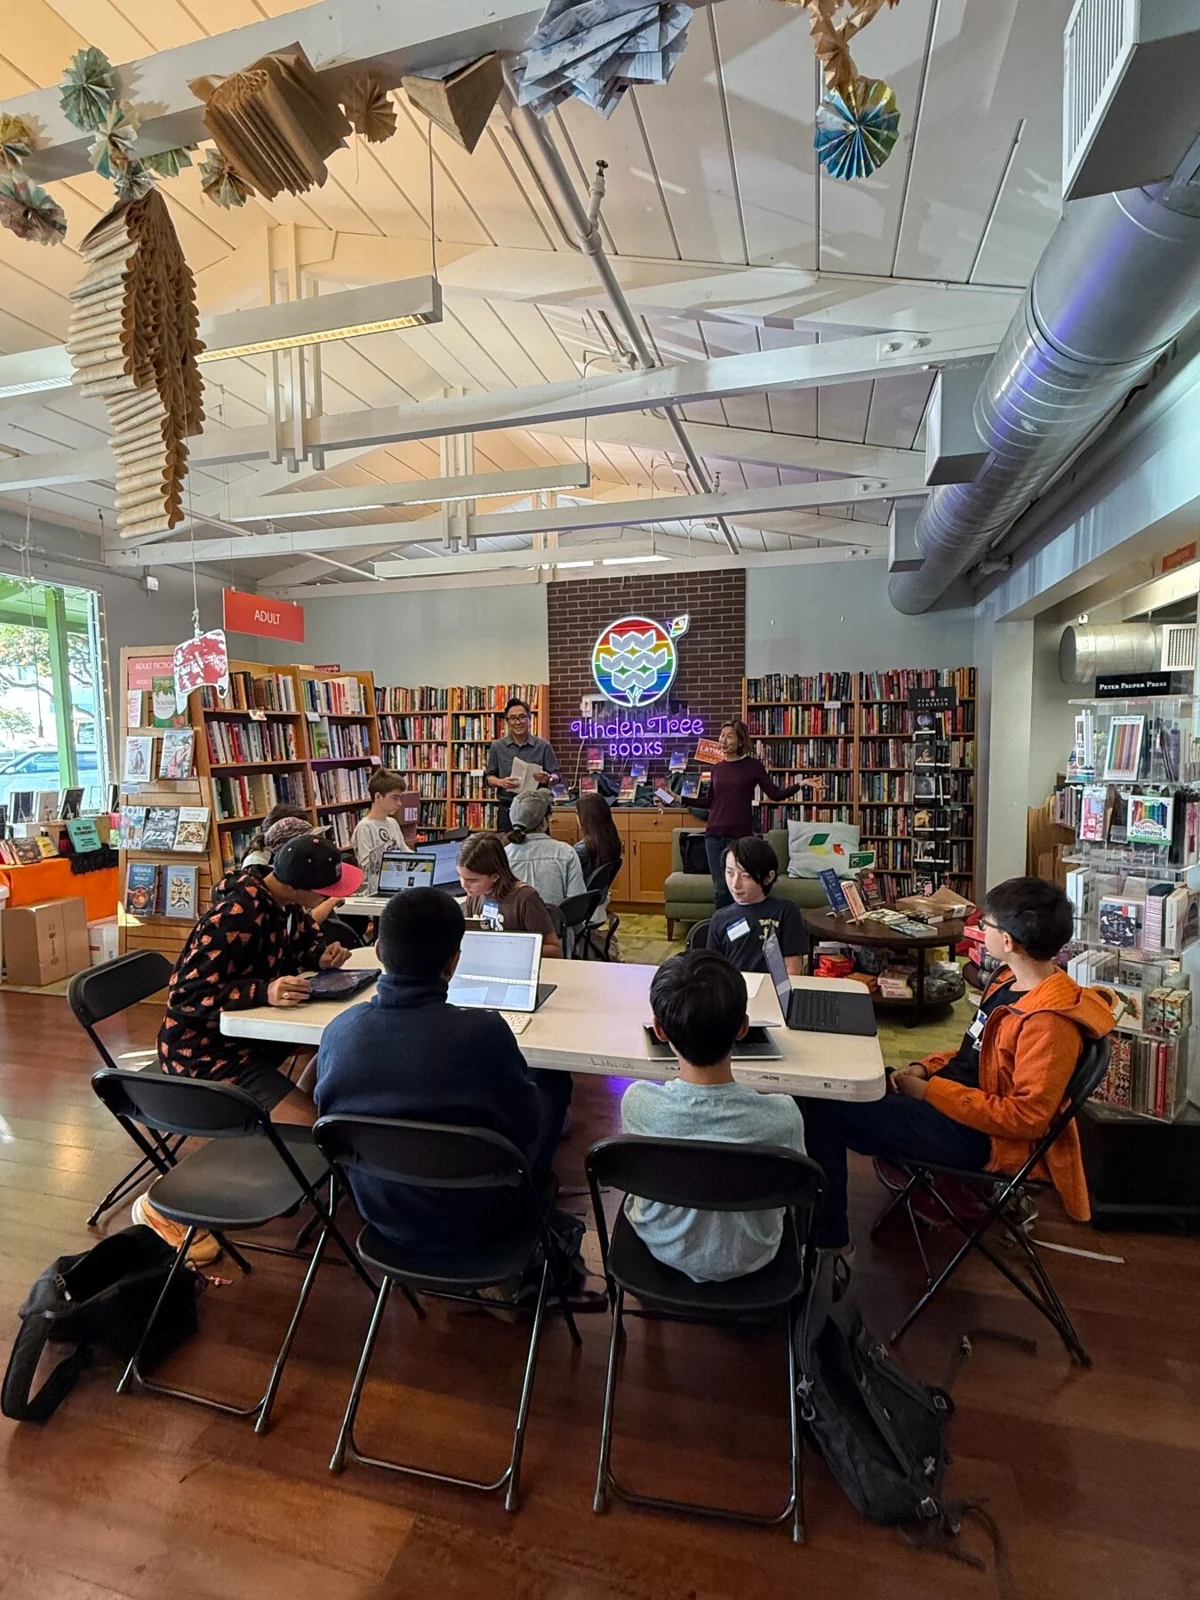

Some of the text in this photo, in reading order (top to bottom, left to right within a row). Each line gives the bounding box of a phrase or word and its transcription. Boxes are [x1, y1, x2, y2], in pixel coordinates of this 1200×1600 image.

[254, 609, 281, 625] ADULT
[135, 662, 153, 670] ADULT
[1099, 683, 1120, 691] PETER
[1121, 682, 1145, 690] PAUPER
[571, 715, 704, 740] Linden Tree
[609, 741, 663, 757] BOOKS
[120, 806, 144, 816] SOJU
